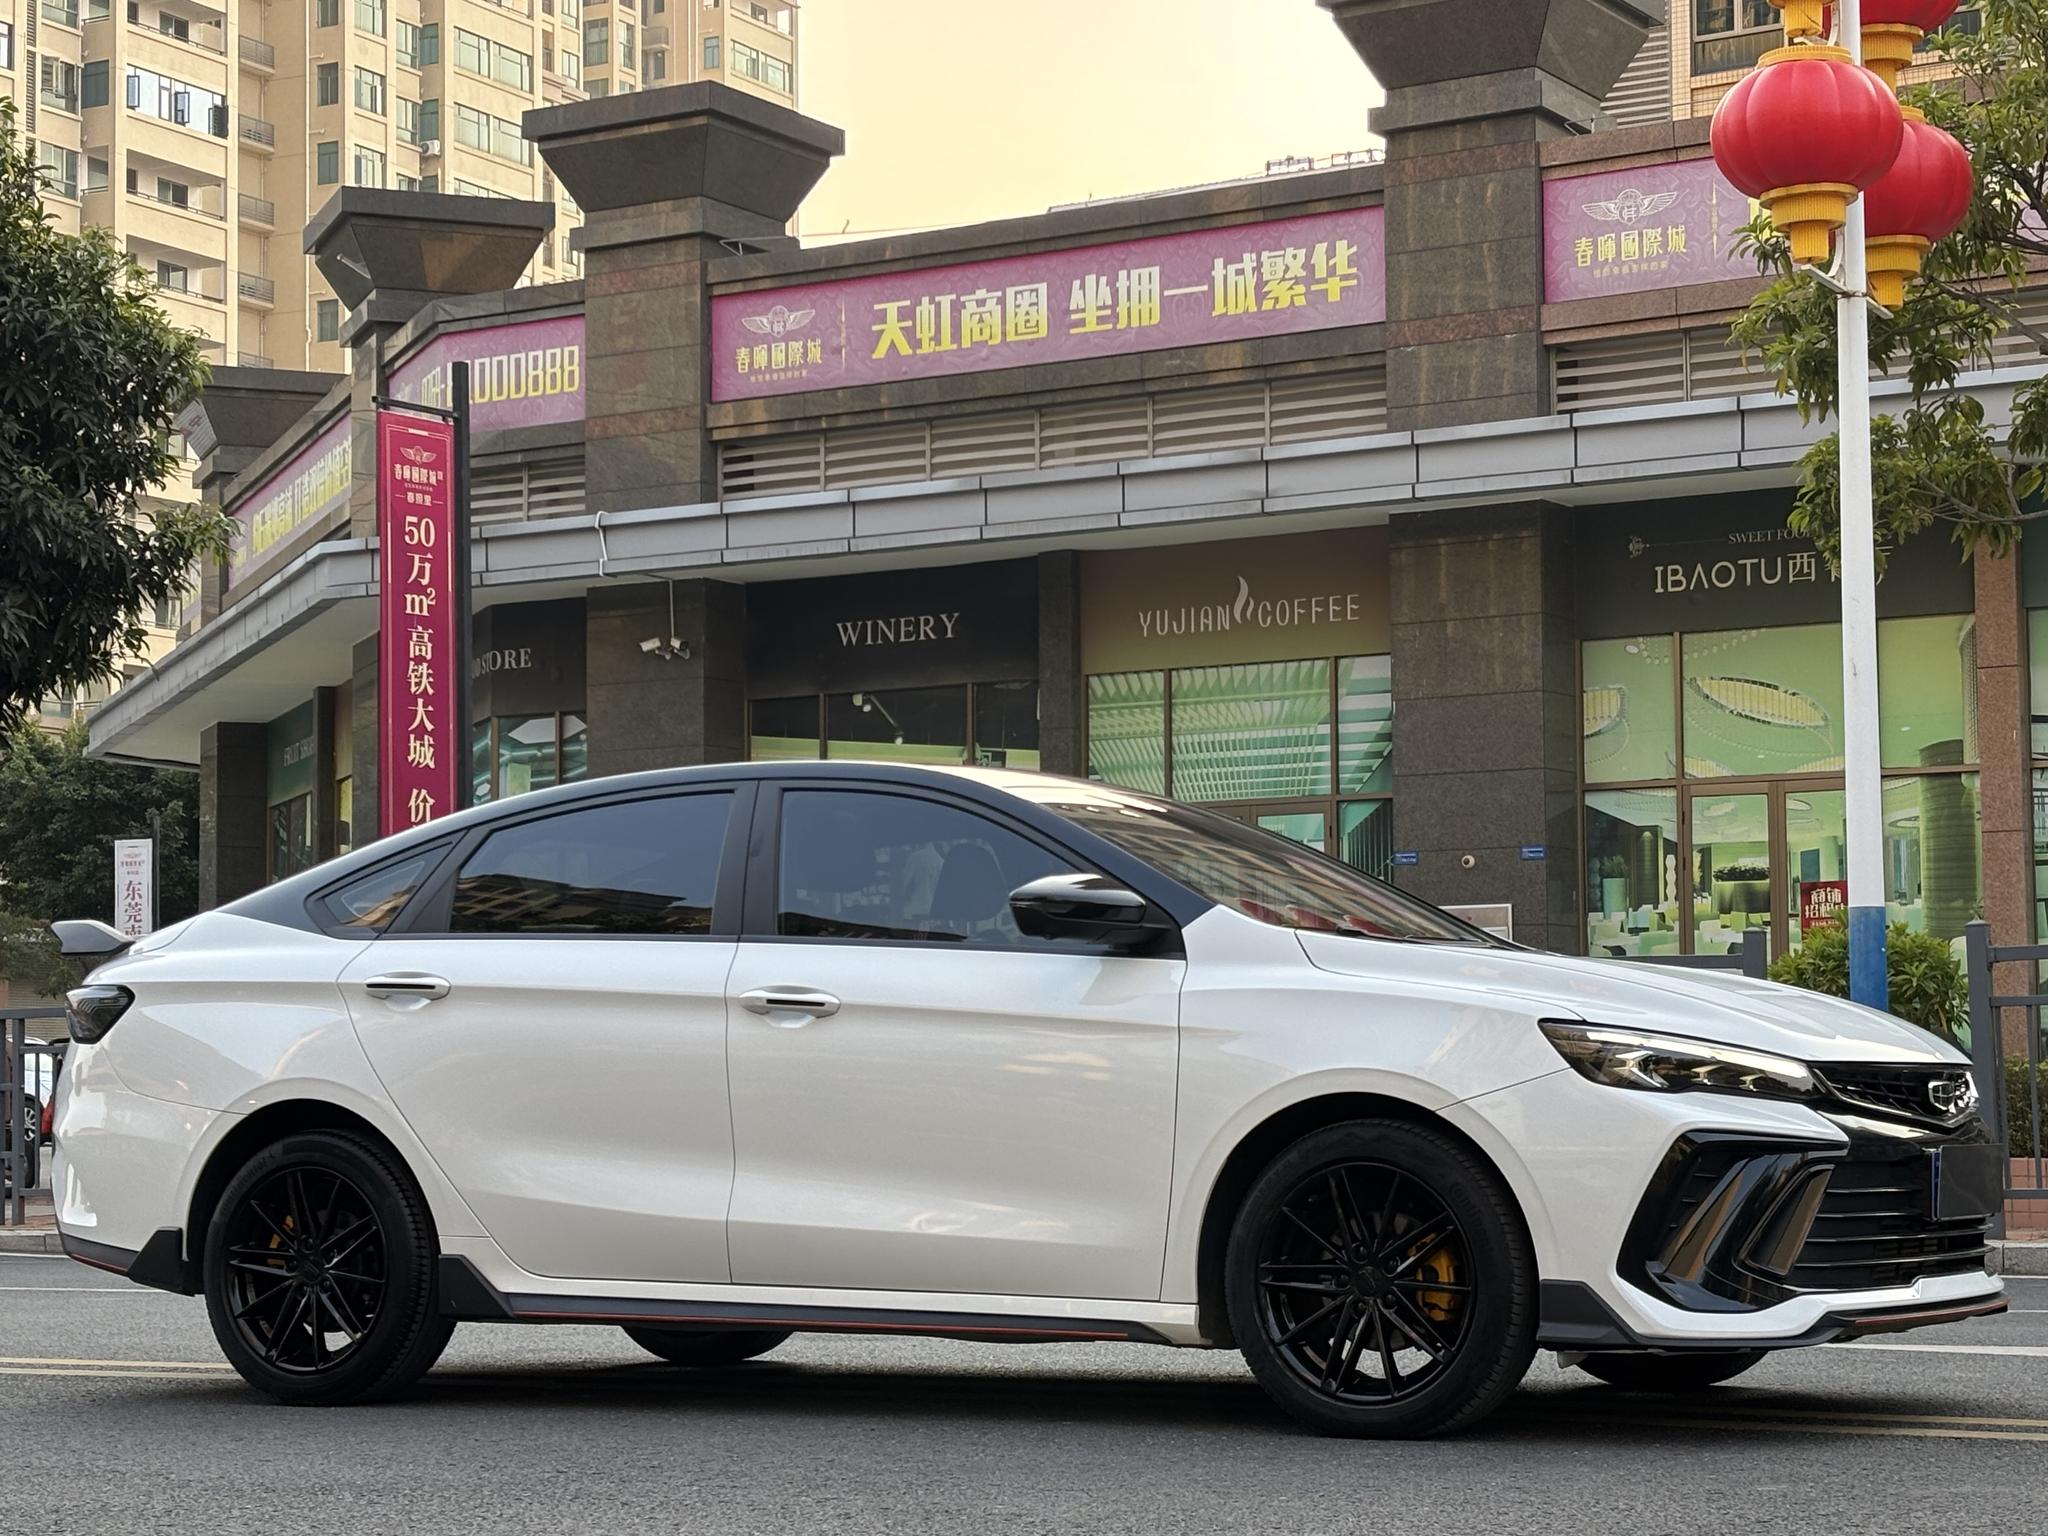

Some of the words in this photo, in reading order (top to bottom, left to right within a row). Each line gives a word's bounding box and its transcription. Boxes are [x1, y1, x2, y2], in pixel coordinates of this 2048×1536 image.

[871, 282, 1048, 359] 天虹商圈
[1069, 239, 1359, 334] 坐拥一城繁华
[1728, 529, 1773, 545] SWEET
[836, 612, 960, 648] WINERY
[1138, 604, 1230, 638] YUJIAN
[1257, 594, 1361, 628] COFFEE
[481, 647, 532, 675] STORE
